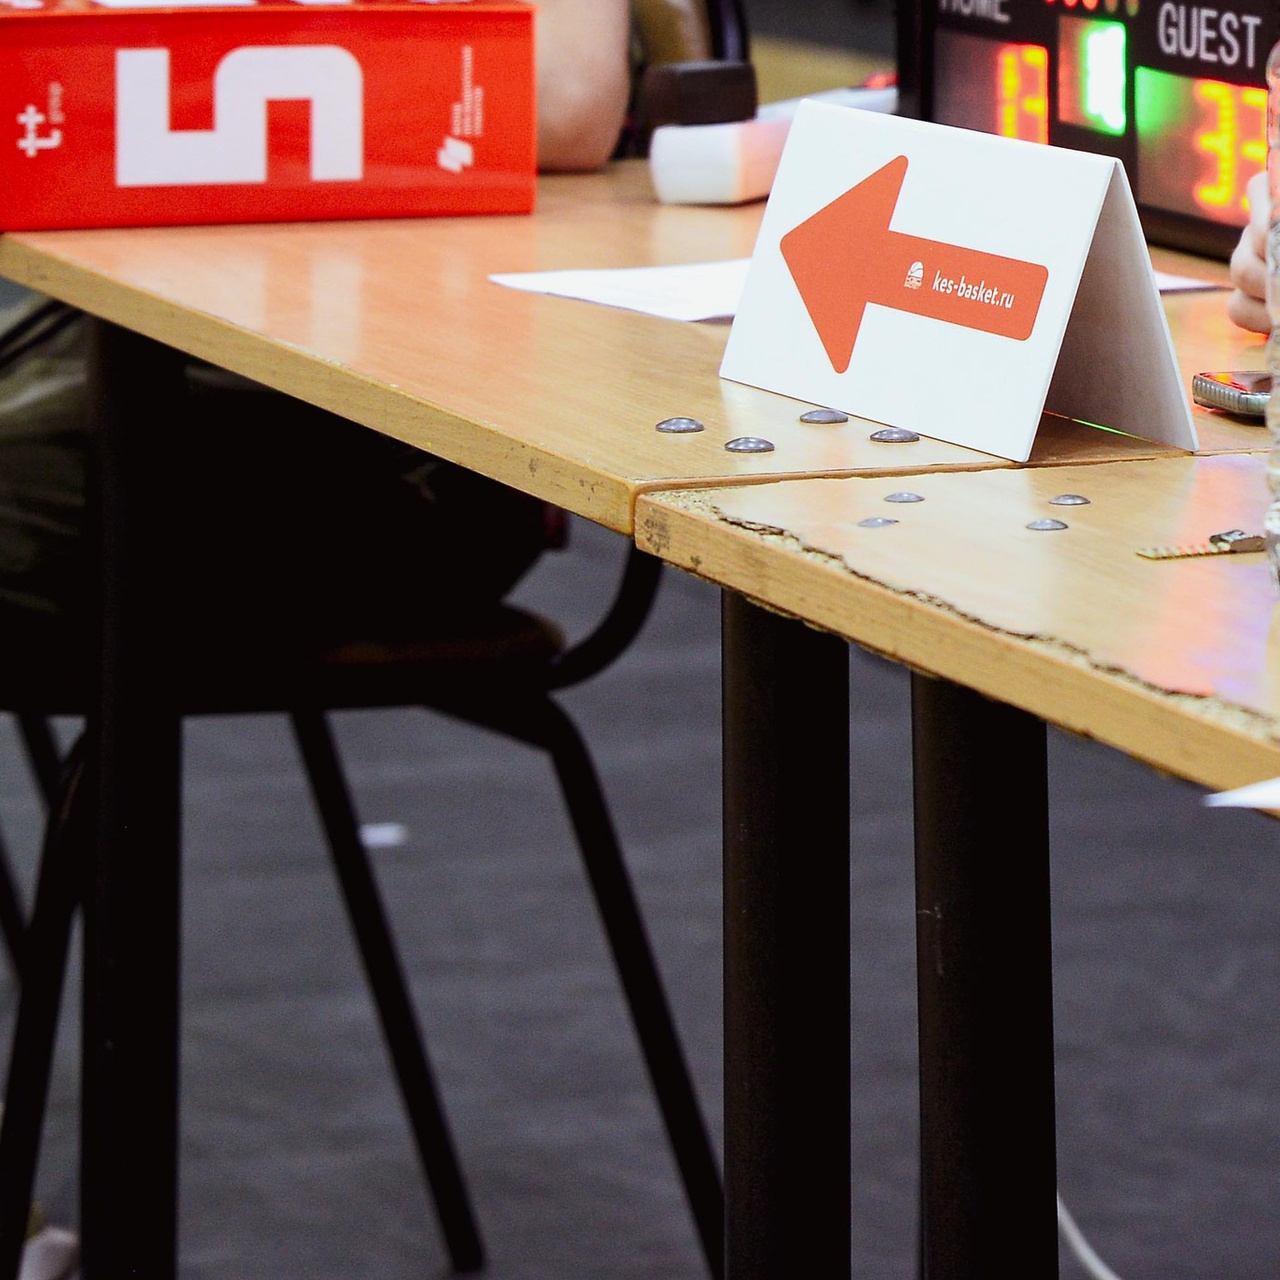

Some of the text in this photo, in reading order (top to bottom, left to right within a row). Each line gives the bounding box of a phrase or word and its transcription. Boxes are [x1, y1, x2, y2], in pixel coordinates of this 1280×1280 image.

[1157, 0, 1263, 69] GUEST
[115, 44, 364, 187] 5
[932, 270, 1015, 308] kes-basket.ru
